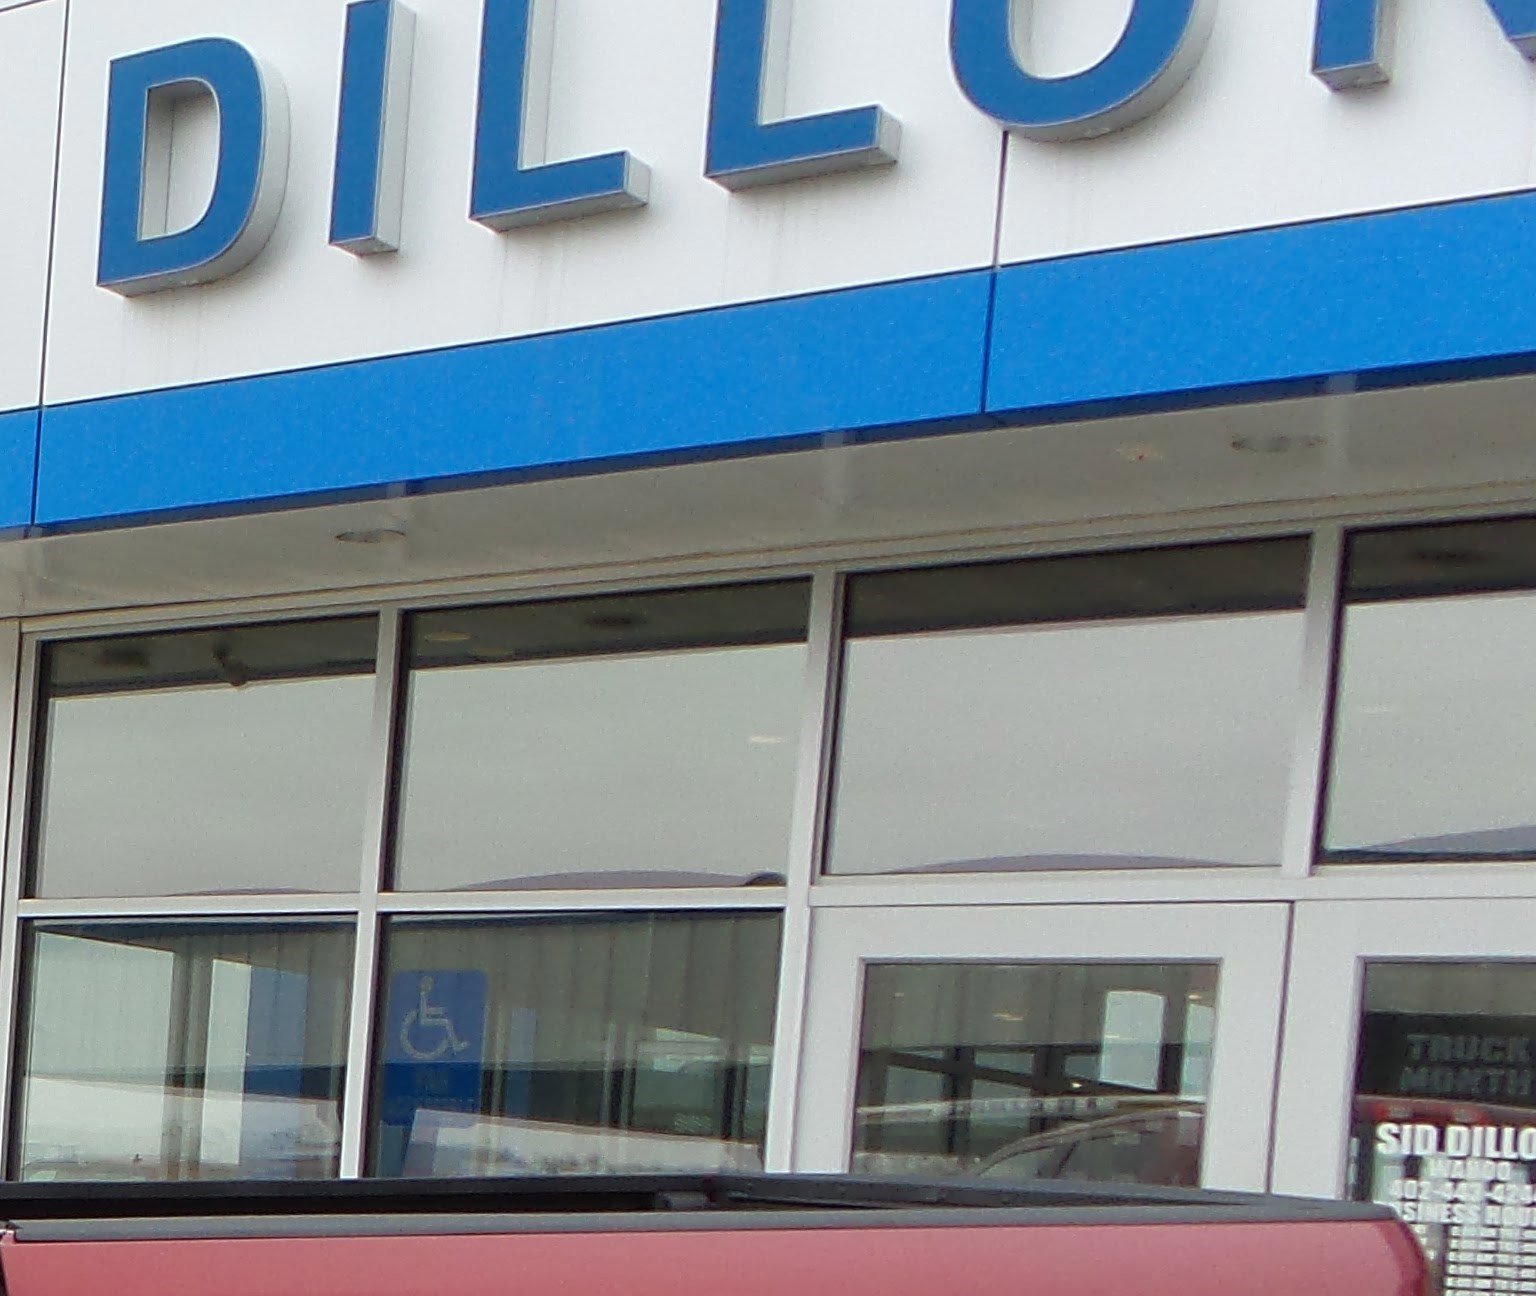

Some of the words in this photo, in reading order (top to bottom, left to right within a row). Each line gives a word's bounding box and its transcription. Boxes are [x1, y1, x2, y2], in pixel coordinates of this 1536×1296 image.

[95, 0, 1536, 300] DILL
[1376, 1122, 1437, 1156] SID
[1387, 1200, 1481, 1225] SINESS
